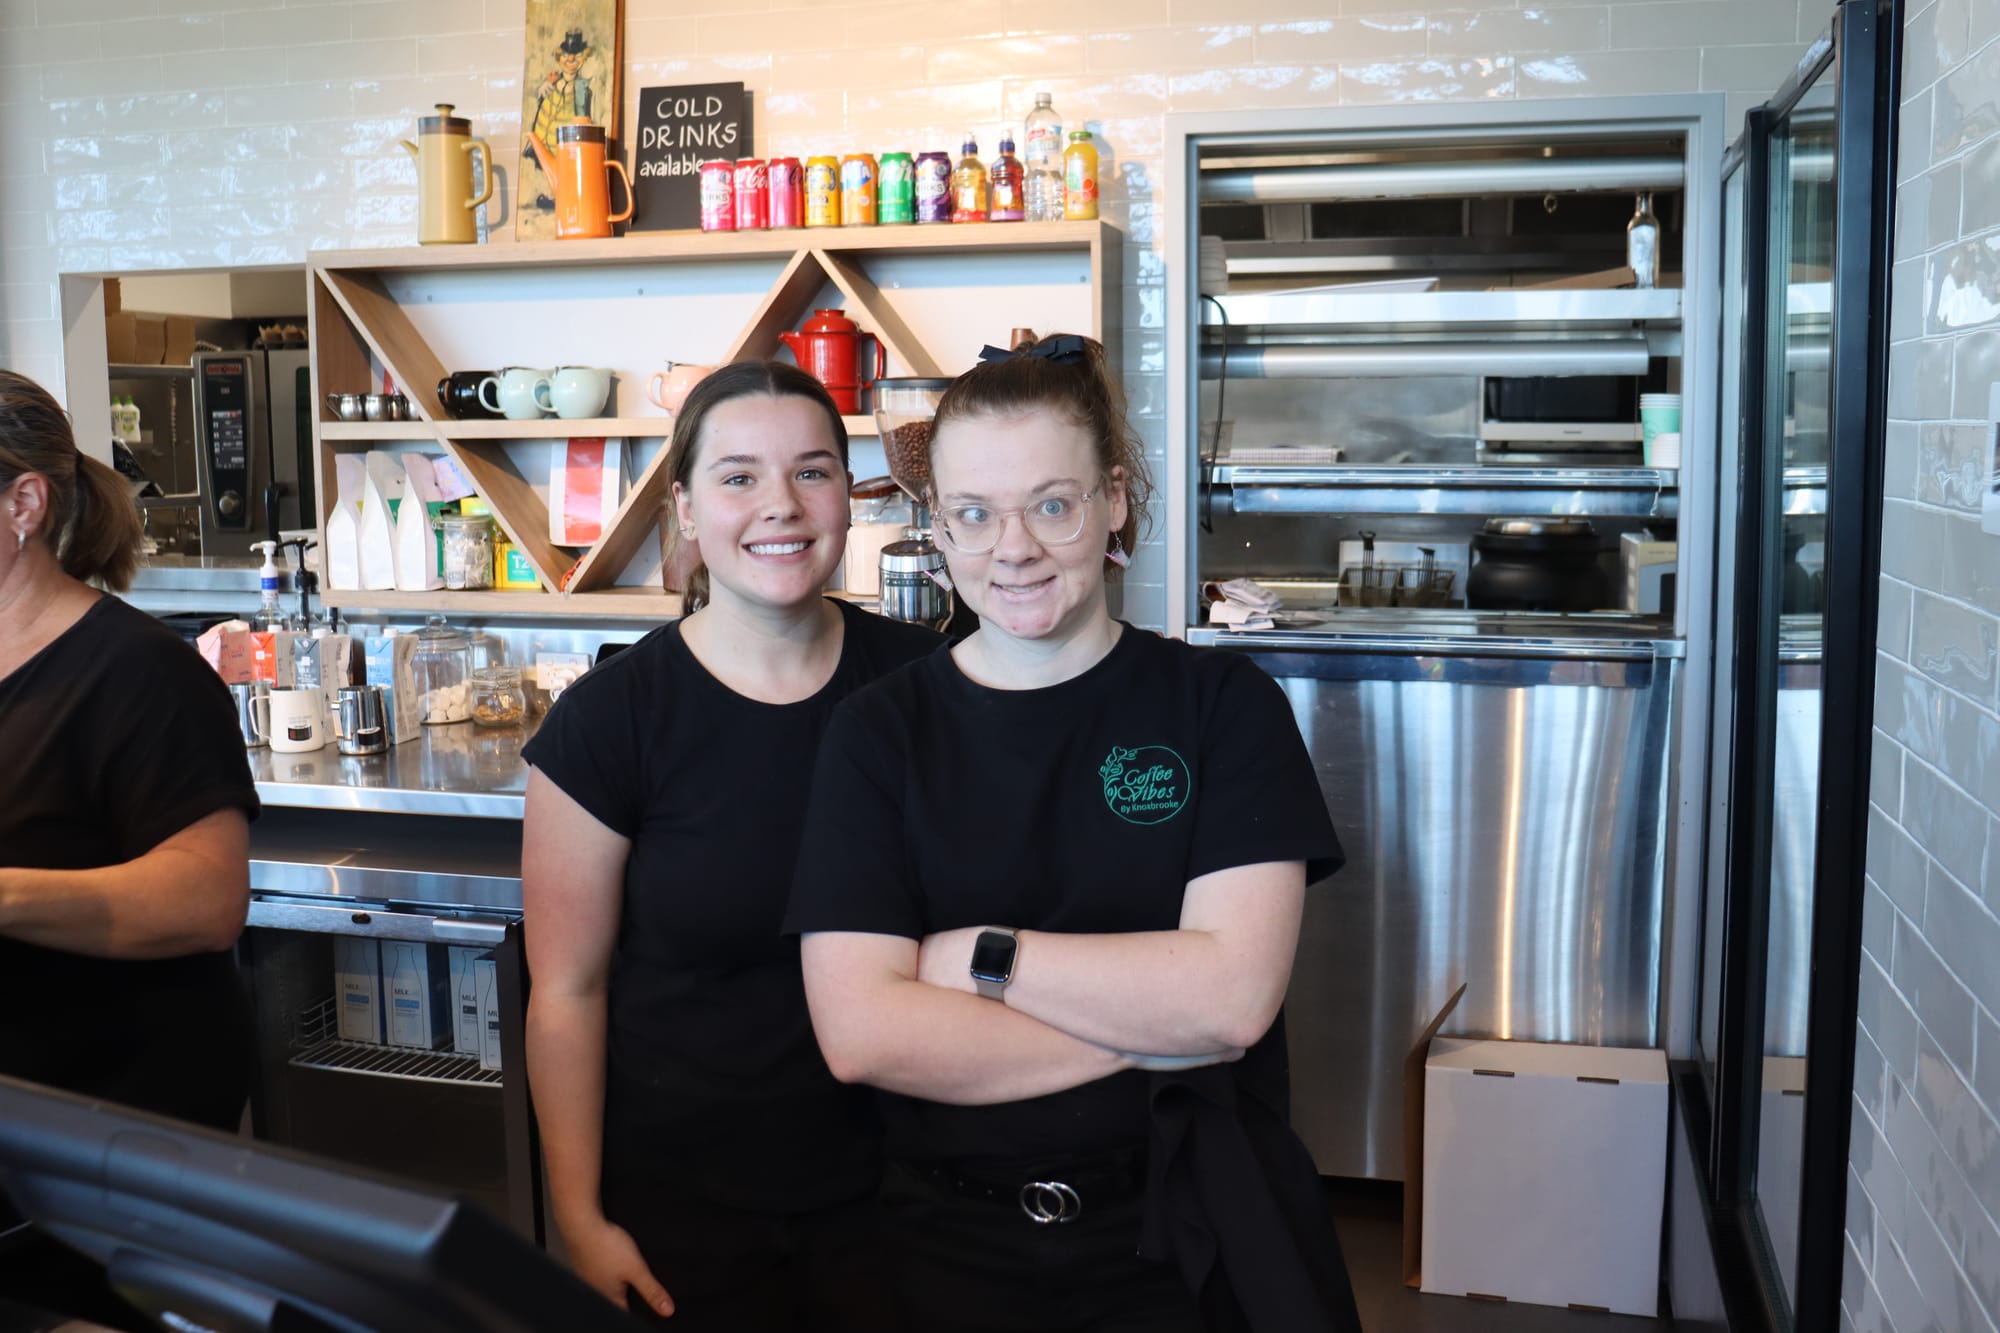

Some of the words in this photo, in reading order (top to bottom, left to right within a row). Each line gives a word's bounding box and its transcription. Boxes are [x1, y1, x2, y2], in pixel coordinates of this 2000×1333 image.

[656, 96, 723, 119] COLD
[642, 121, 738, 150] DRINKS
[639, 152, 704, 177] available
[1124, 764, 1174, 786] Coffee
[1127, 783, 1176, 802] Vibes
[1120, 805, 1131, 814] By
